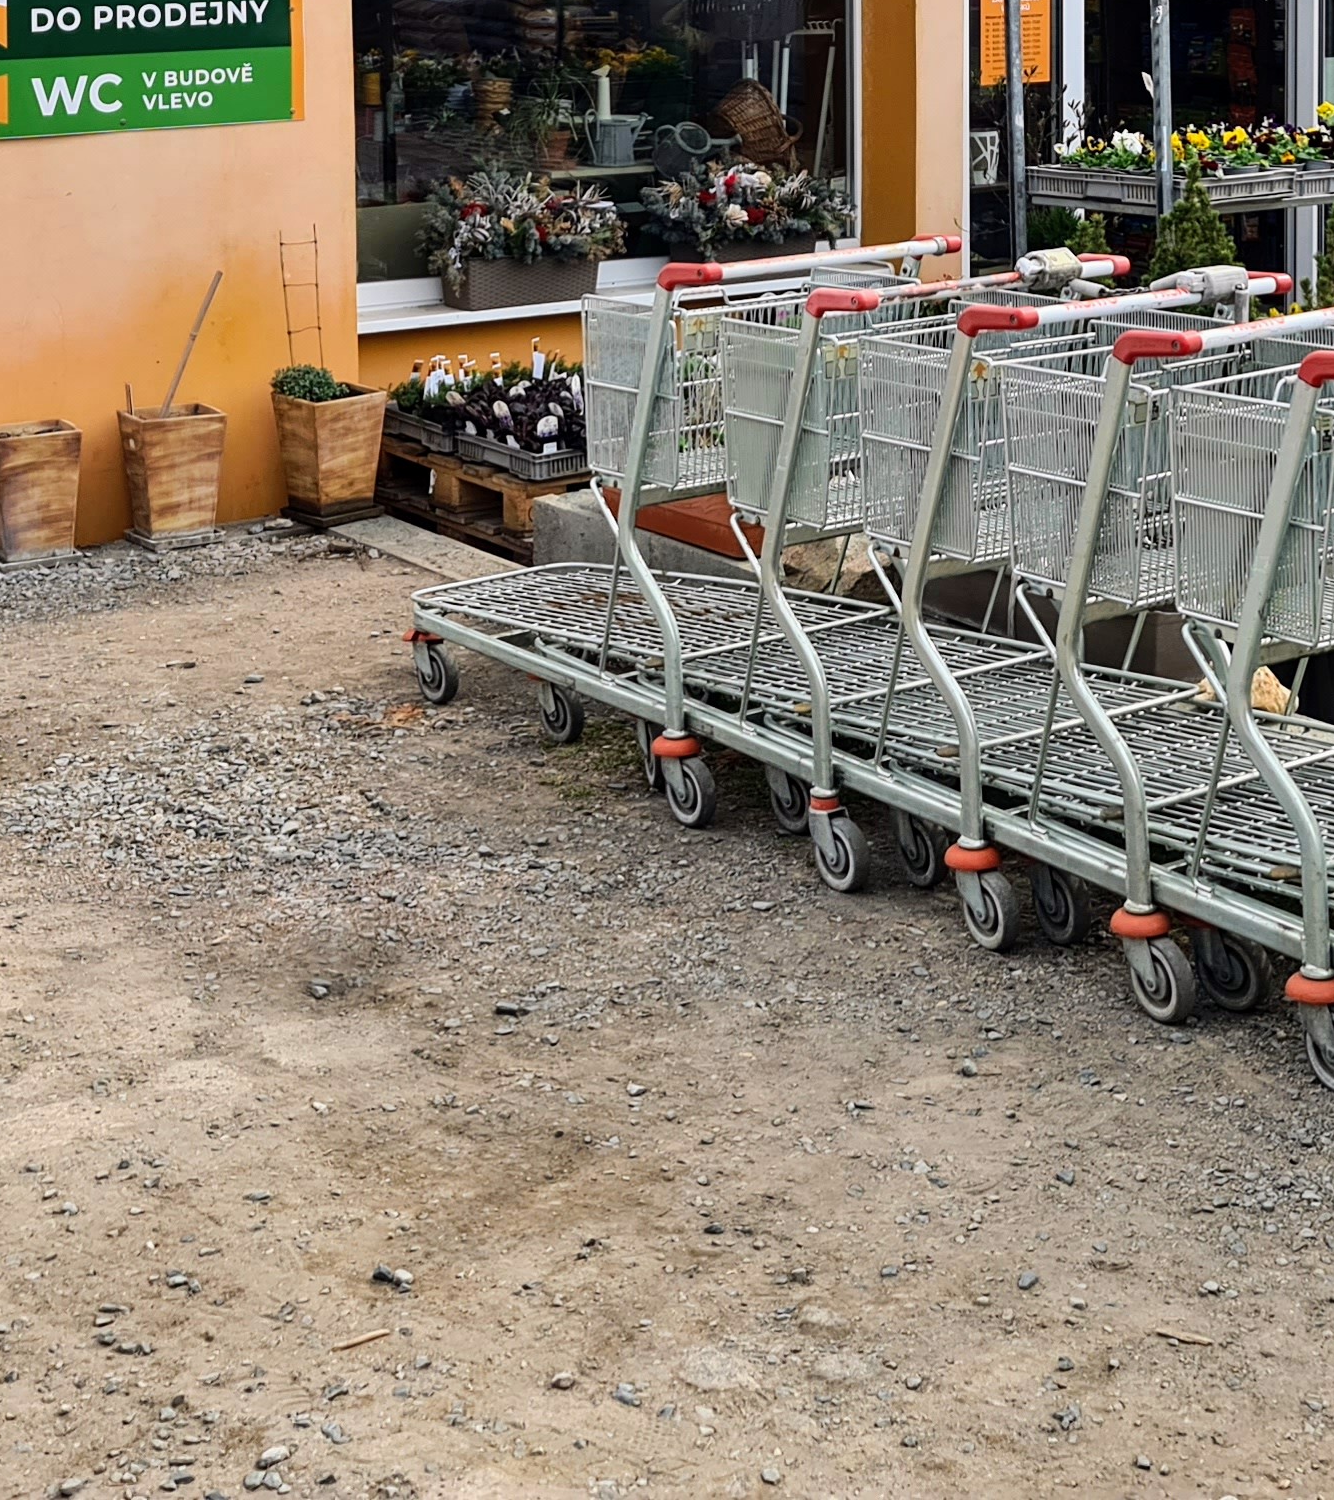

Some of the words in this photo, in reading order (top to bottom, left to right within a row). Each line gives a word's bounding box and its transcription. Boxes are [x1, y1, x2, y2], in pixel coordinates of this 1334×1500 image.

[31, 7, 81, 33] DO
[94, 0, 269, 30] PRODEJNY
[141, 71, 157, 88] V
[164, 62, 254, 87] BUDOVĚ
[31, 73, 123, 117] WC
[142, 91, 213, 110] VLEVO
